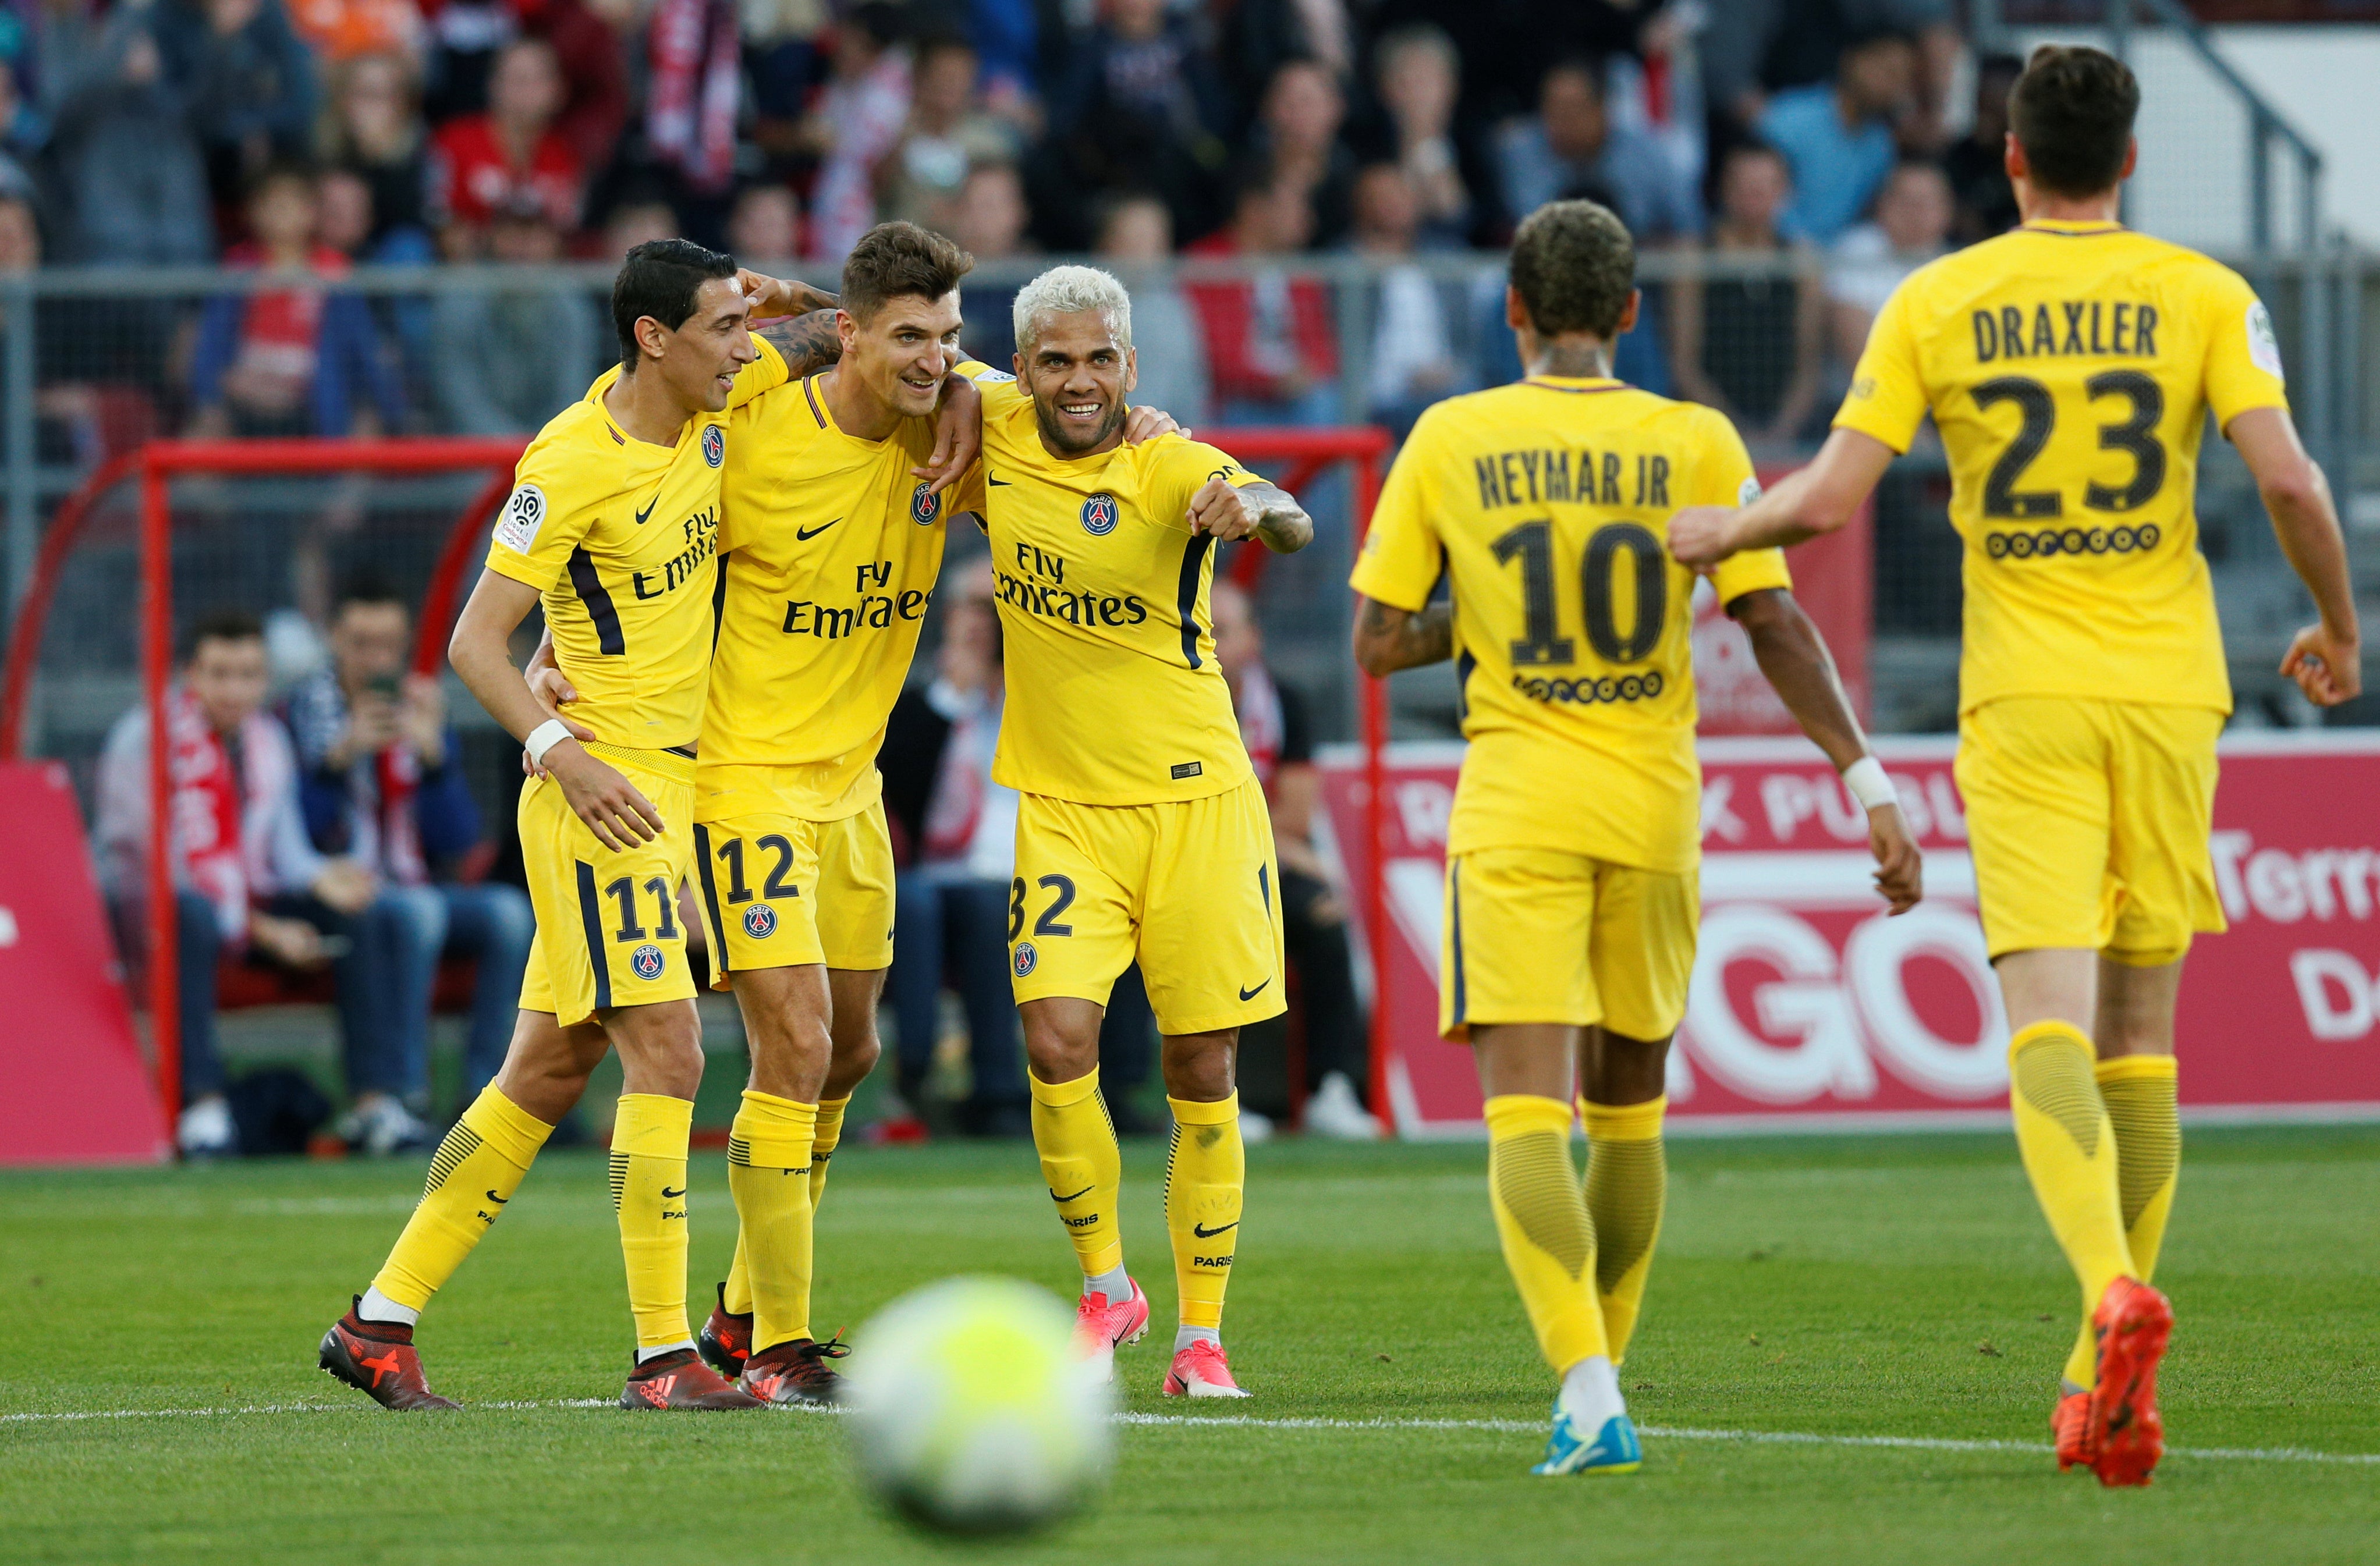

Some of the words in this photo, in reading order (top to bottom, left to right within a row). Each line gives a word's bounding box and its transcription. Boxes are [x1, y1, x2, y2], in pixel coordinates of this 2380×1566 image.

[1973, 301, 2158, 363] DRAXLER
[1969, 371, 2167, 517] 23
[1475, 449, 1622, 510] NEYMAR
[1635, 454, 1670, 507] JR
[1089, 496, 1112, 506] PARIS
[502, 523, 528, 545] Conforama
[507, 519, 525, 534] LIGUE
[683, 506, 718, 544] Fly
[856, 561, 892, 592] Fy
[1016, 542, 1063, 584] Fly
[992, 567, 1147, 626] mirates
[1489, 518, 1668, 665] 10
[782, 589, 934, 639] Emrae
[717, 835, 799, 904] 12
[605, 876, 679, 942] 11
[747, 907, 769, 915] PARIS
[1009, 874, 1076, 943] 32
[636, 947, 658, 957] PARIS
[1194, 1255, 1233, 1267] PARIS
[640, 1386, 668, 1409] adidas
